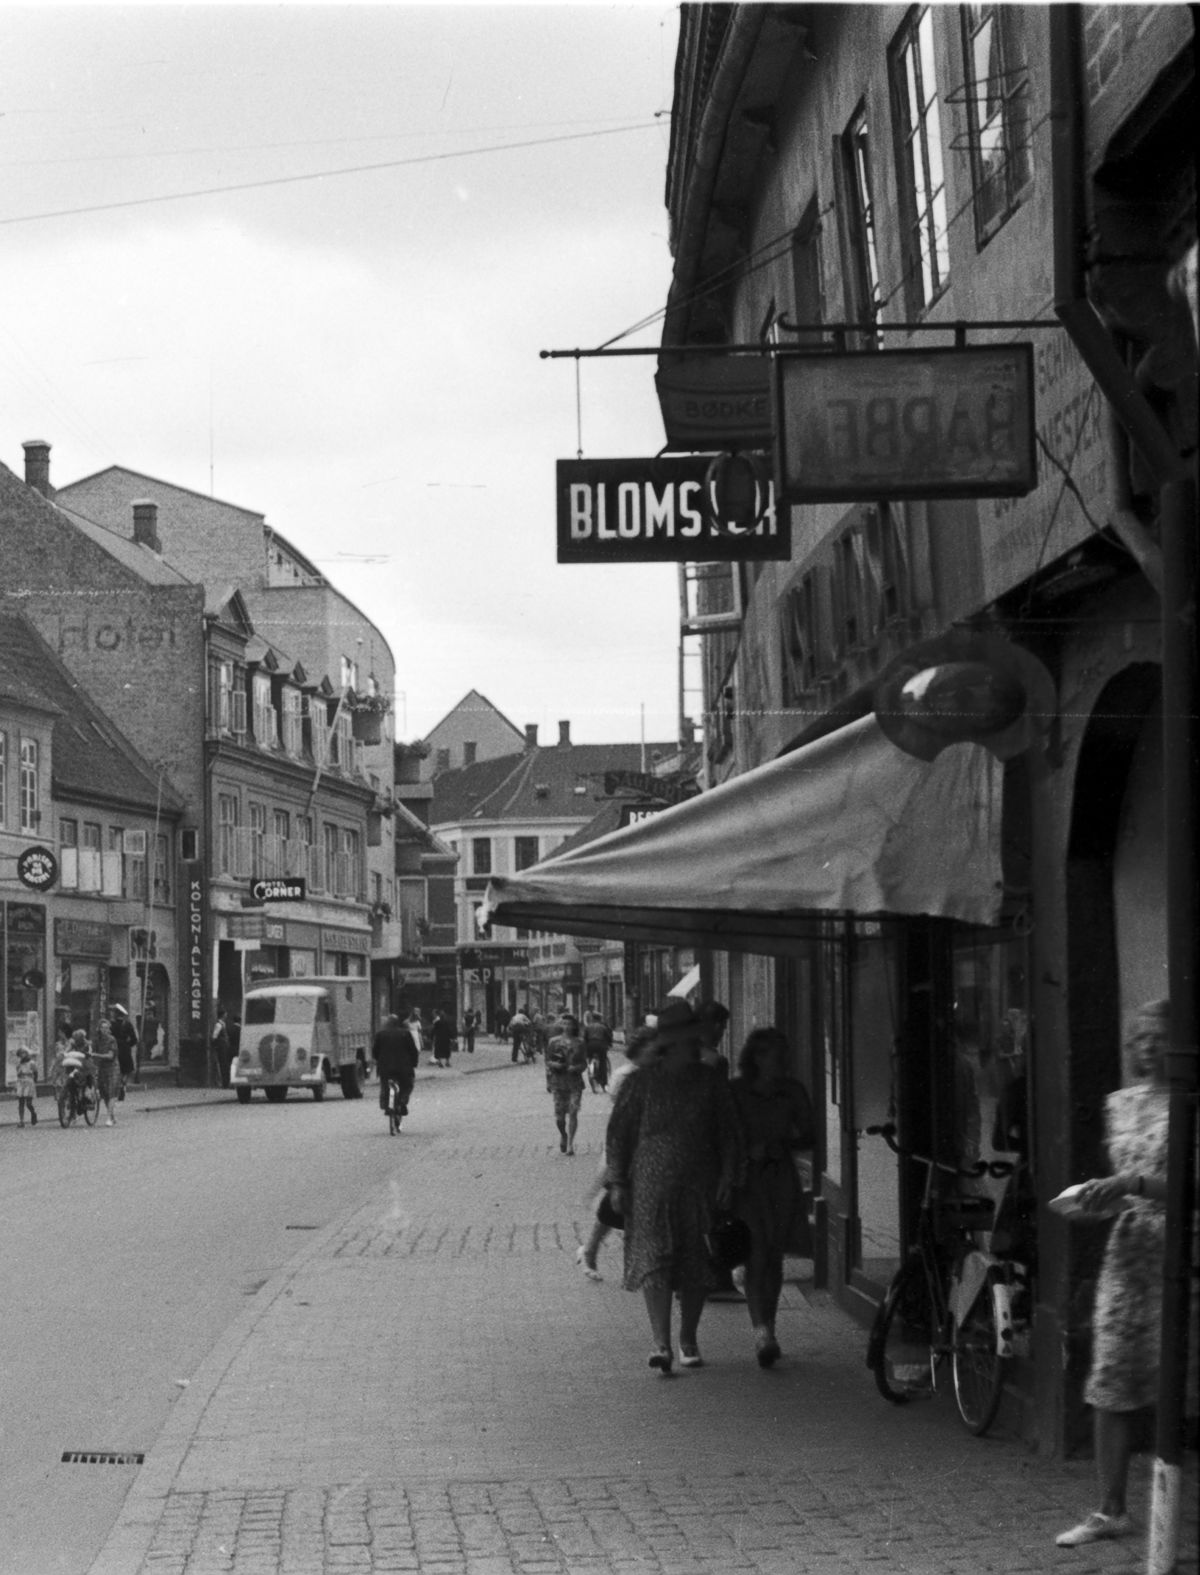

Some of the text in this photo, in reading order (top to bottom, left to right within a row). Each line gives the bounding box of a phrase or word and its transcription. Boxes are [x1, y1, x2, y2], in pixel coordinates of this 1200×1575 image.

[685, 398, 769, 419] BØDKE
[569, 480, 777, 538] BLOMSR
[253, 883, 302, 900] CORNER
[191, 881, 202, 1020] KOLONIALLAGER
